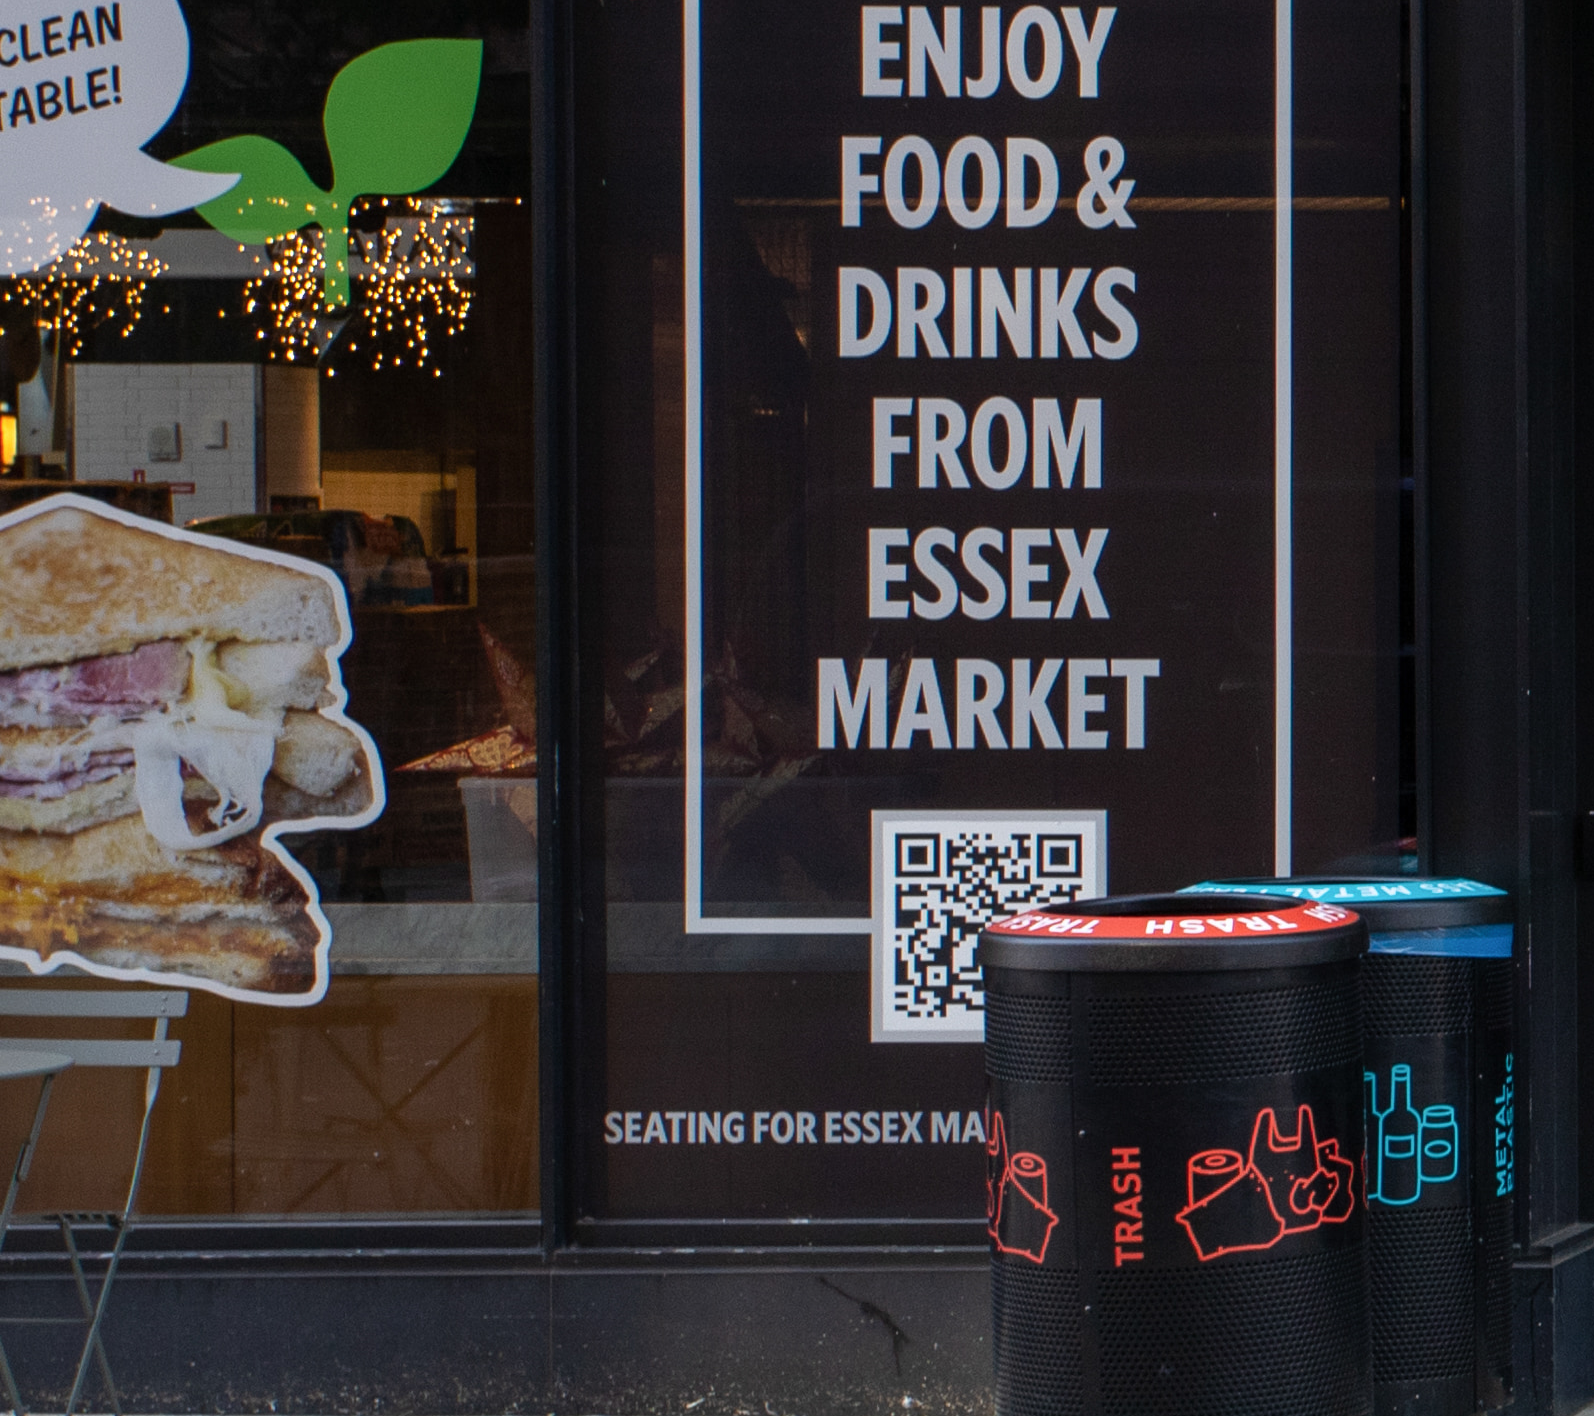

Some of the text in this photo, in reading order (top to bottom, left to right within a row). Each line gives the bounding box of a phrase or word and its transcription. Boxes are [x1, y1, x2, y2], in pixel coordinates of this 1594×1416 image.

[0, 1, 122, 68] CLEAN
[862, 6, 1116, 98] ENJOY
[842, 136, 1138, 229] FOOD &
[839, 267, 1138, 359] DRINKS
[873, 397, 1101, 489] FROM
[868, 528, 1109, 619] ESSEX
[818, 659, 1160, 749] MARKET
[1145, 914, 1298, 935] TRASH
[1285, 883, 1411, 899] METAL
[605, 1111, 745, 1144] SEATING
[752, 1111, 818, 1144] FOR
[824, 1111, 923, 1144] ESSEX
[1495, 1083, 1508, 1197] METAL
[1111, 1146, 1144, 1268] TRASH
